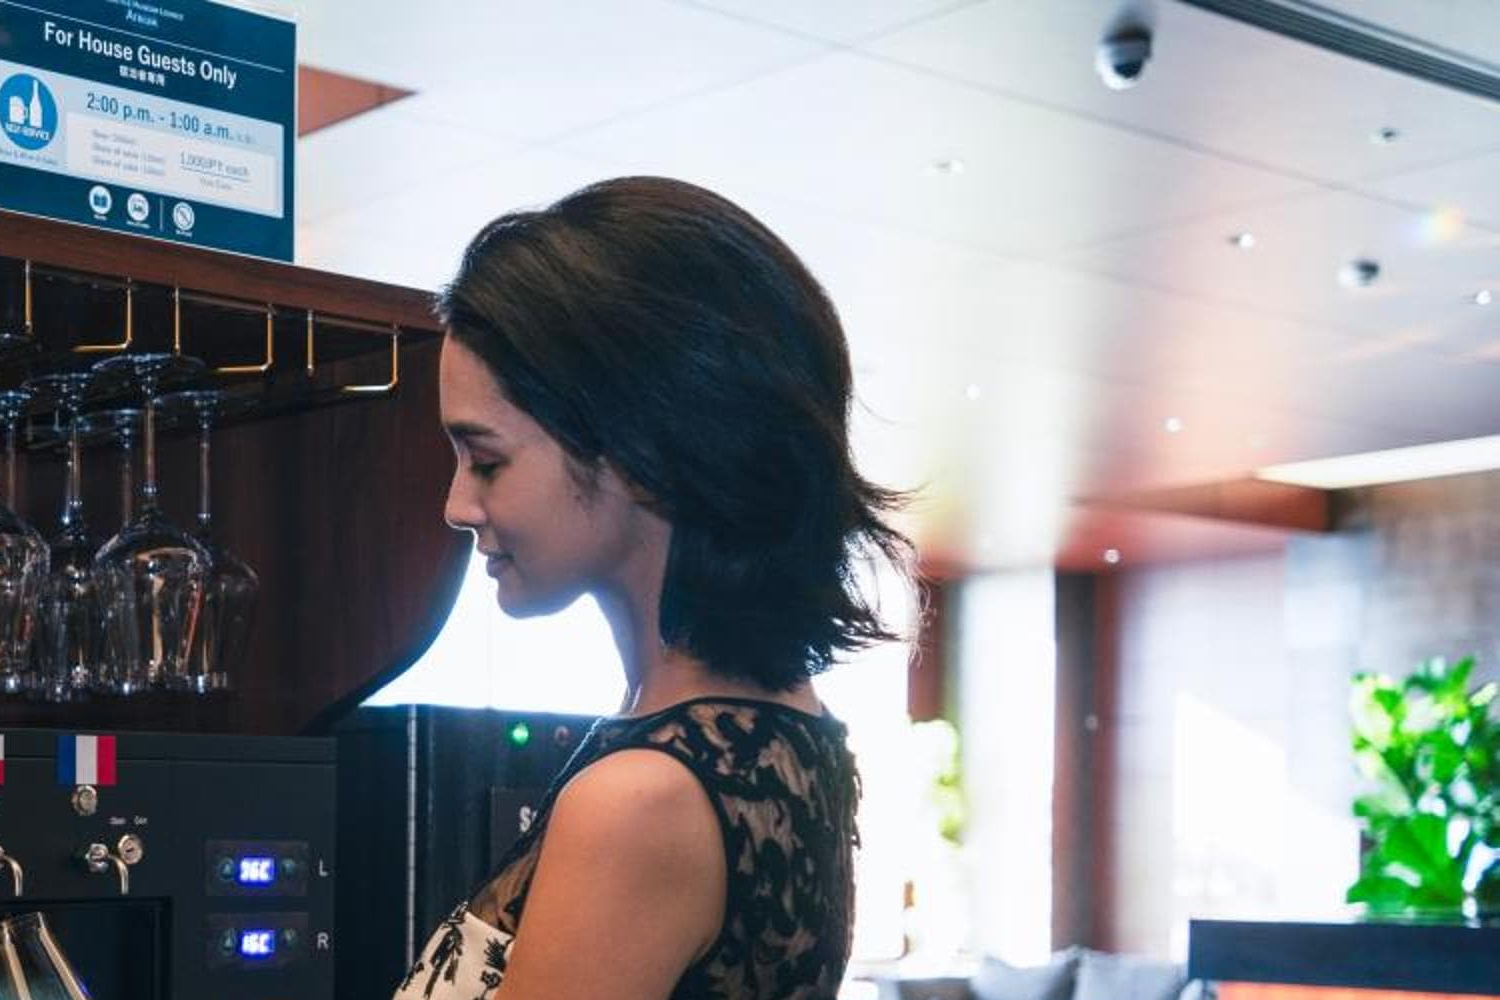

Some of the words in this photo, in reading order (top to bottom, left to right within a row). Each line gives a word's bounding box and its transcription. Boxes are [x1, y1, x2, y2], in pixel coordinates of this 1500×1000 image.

[44, 21, 74, 47] For
[78, 29, 133, 62] House
[137, 45, 196, 77] Guests
[199, 61, 237, 90] Only
[87, 92, 119, 115] 2:00
[123, 105, 155, 124] p.m.
[170, 111, 199, 134] 1:00
[203, 123, 234, 141] a.m.
[519, 805, 538, 832] S
[318, 859, 328, 877] L
[316, 931, 329, 950] R
